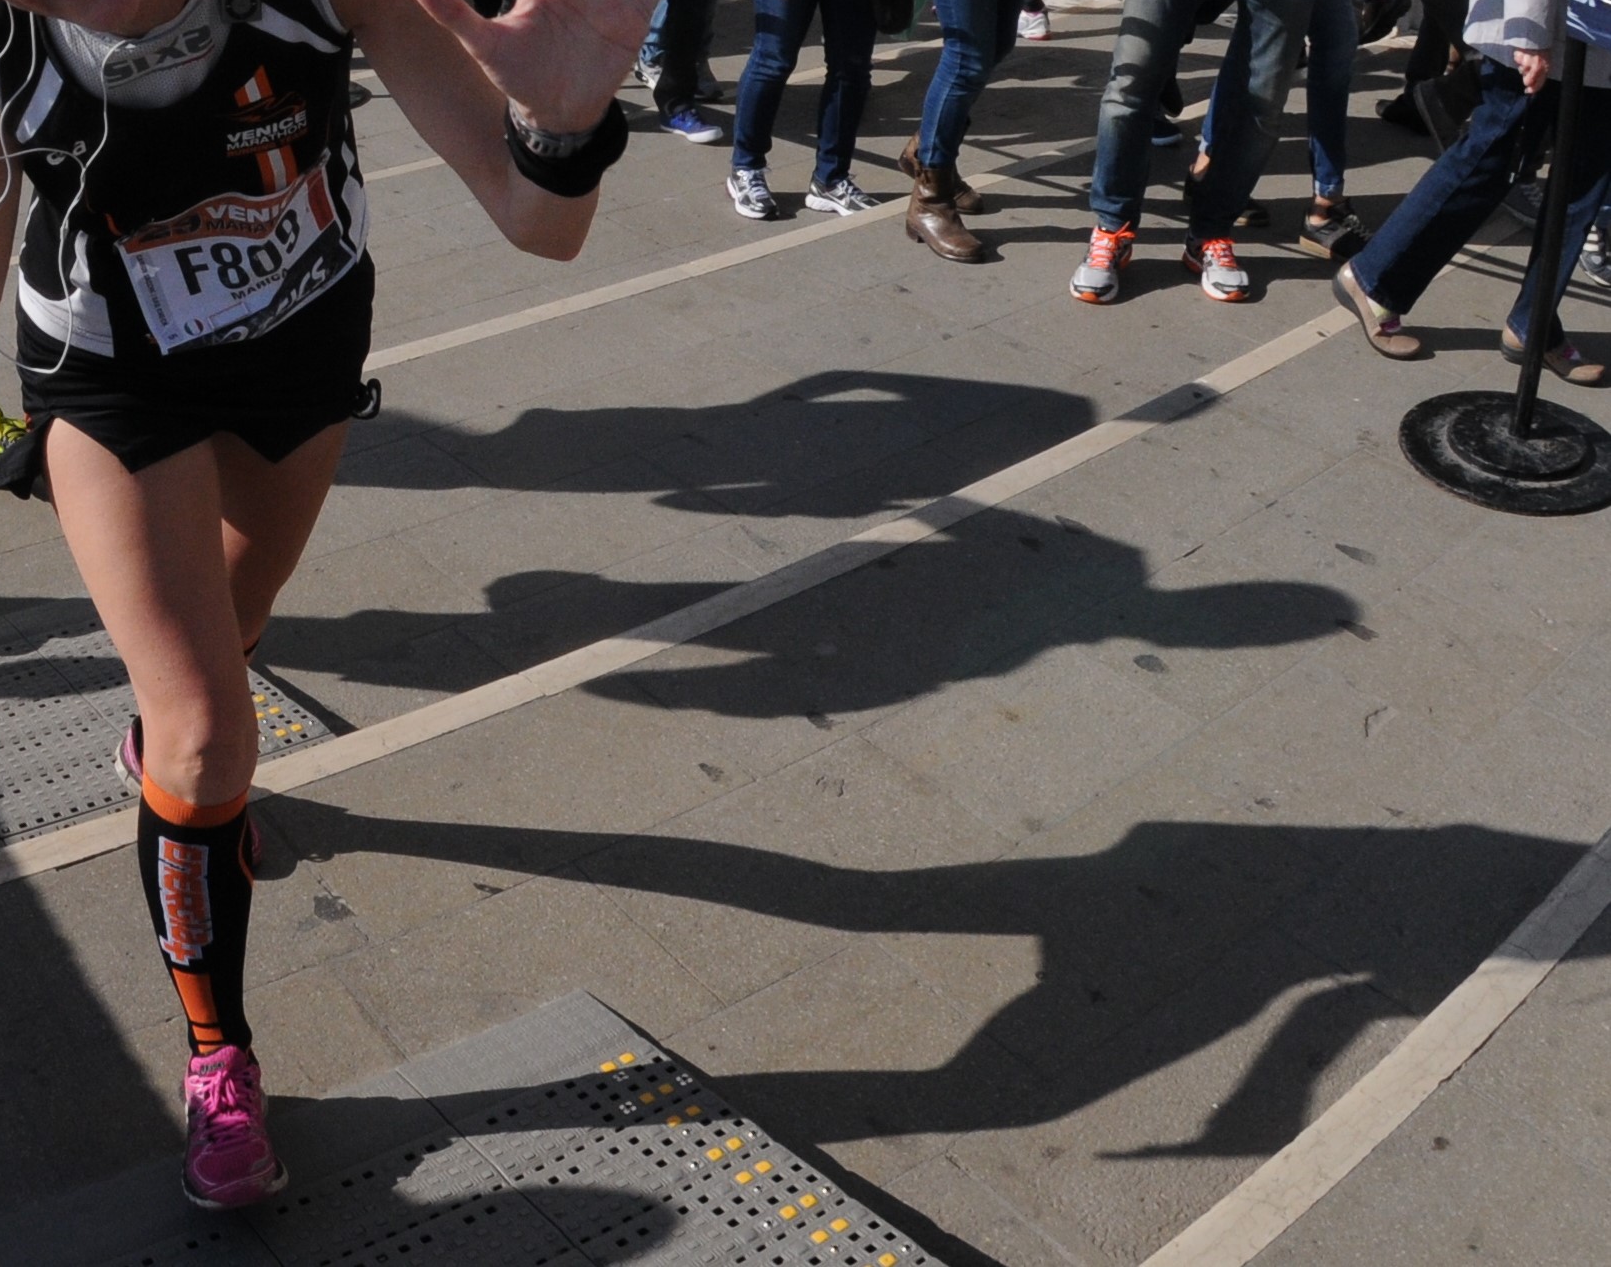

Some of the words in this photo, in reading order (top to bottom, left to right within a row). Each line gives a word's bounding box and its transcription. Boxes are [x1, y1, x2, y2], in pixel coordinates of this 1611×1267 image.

[226, 121, 308, 151] MARATHON
[227, 109, 307, 143] VENICE
[205, 203, 280, 224] VENI
[174, 208, 301, 296] F809
